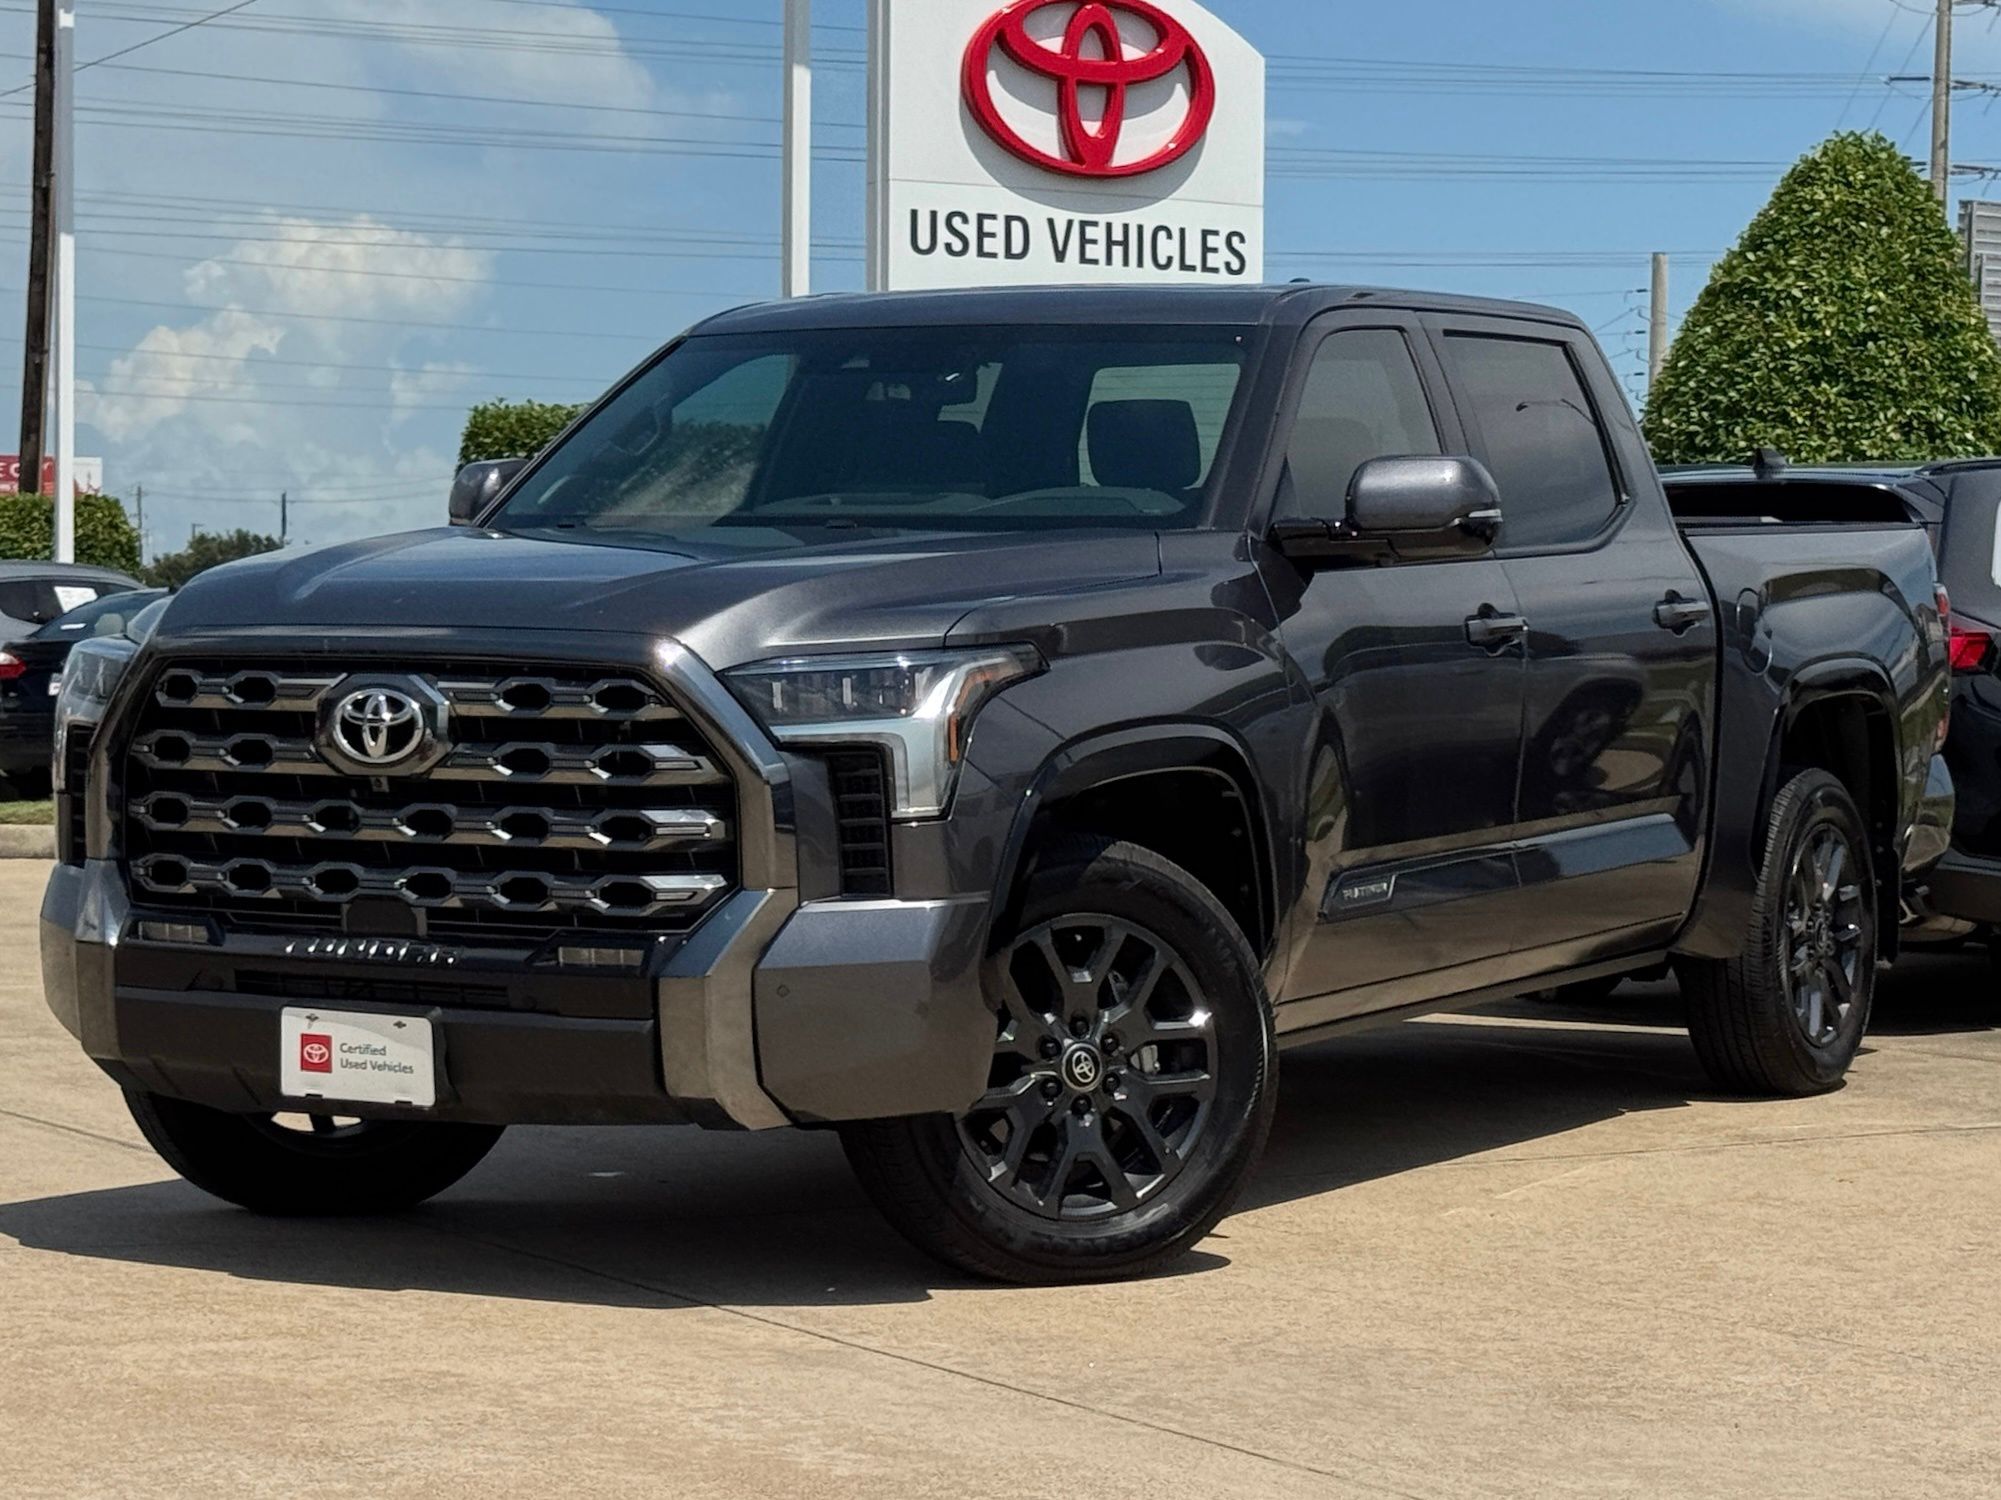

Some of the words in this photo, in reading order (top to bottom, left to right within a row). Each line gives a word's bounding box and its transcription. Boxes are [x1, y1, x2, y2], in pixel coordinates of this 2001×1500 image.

[909, 208, 1030, 261] USED
[1046, 217, 1247, 276] VEHICLES
[340, 1043, 387, 1056] Certified
[340, 1058, 367, 1070] Used
[369, 1060, 414, 1074] Vehicles
